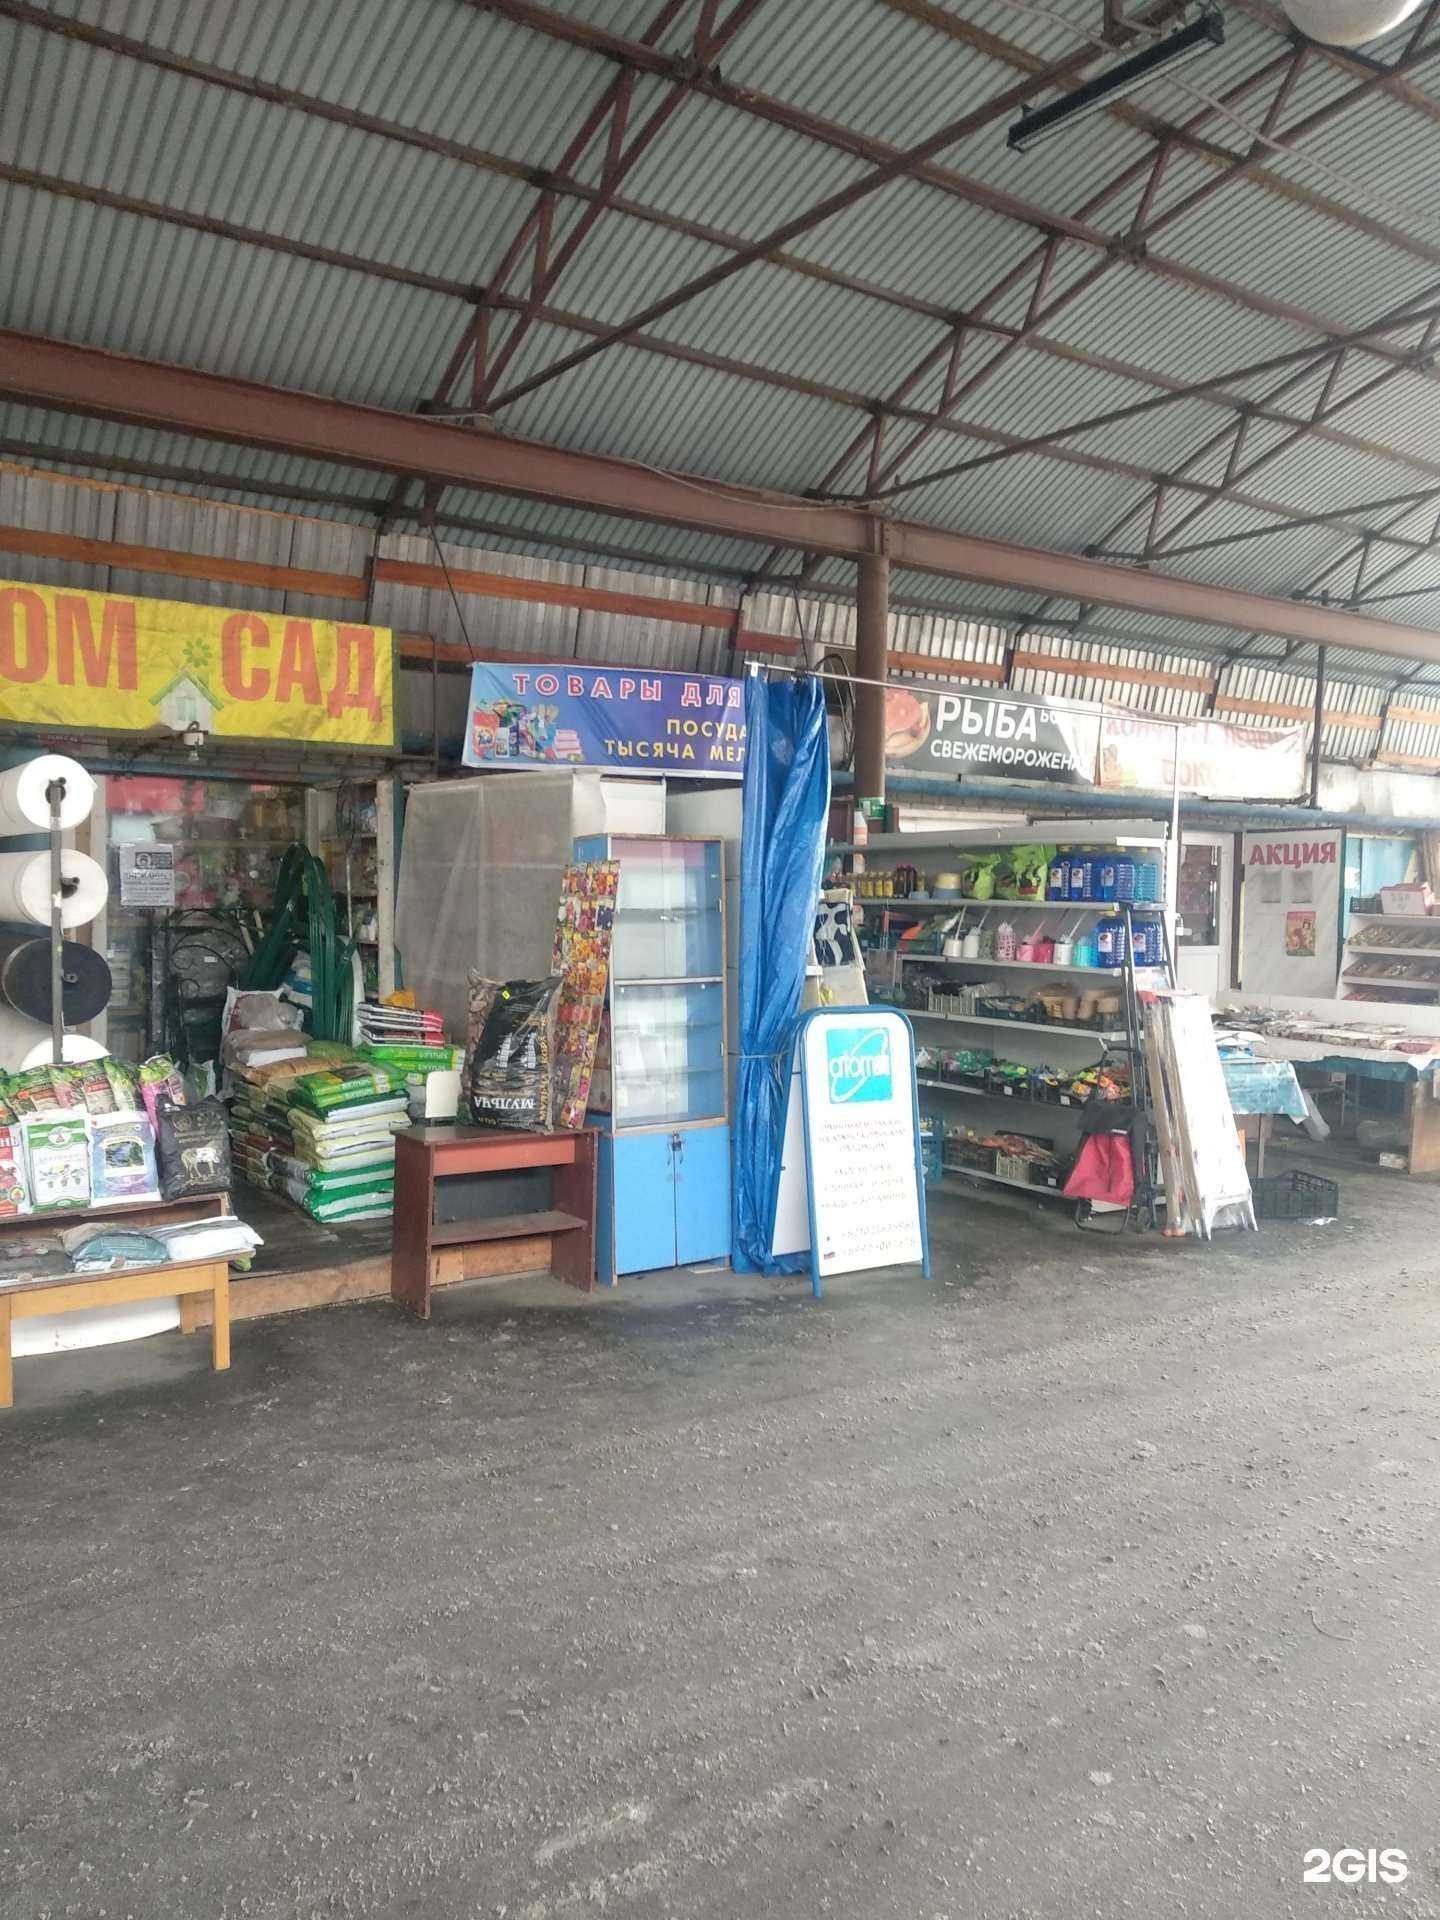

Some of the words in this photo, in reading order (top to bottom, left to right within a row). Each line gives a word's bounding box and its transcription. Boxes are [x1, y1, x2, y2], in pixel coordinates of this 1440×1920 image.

[221, 612, 383, 723] САД
[511, 673, 662, 702] ТОВАРЫ
[681, 682, 741, 708] ДЛЯ
[935, 695, 1038, 743] РЫБА
[603, 738, 695, 760] ТЫСЯЧА
[1249, 841, 1336, 869] АКЦИЯ
[473, 1095, 537, 1110] МУЛЬЧА
